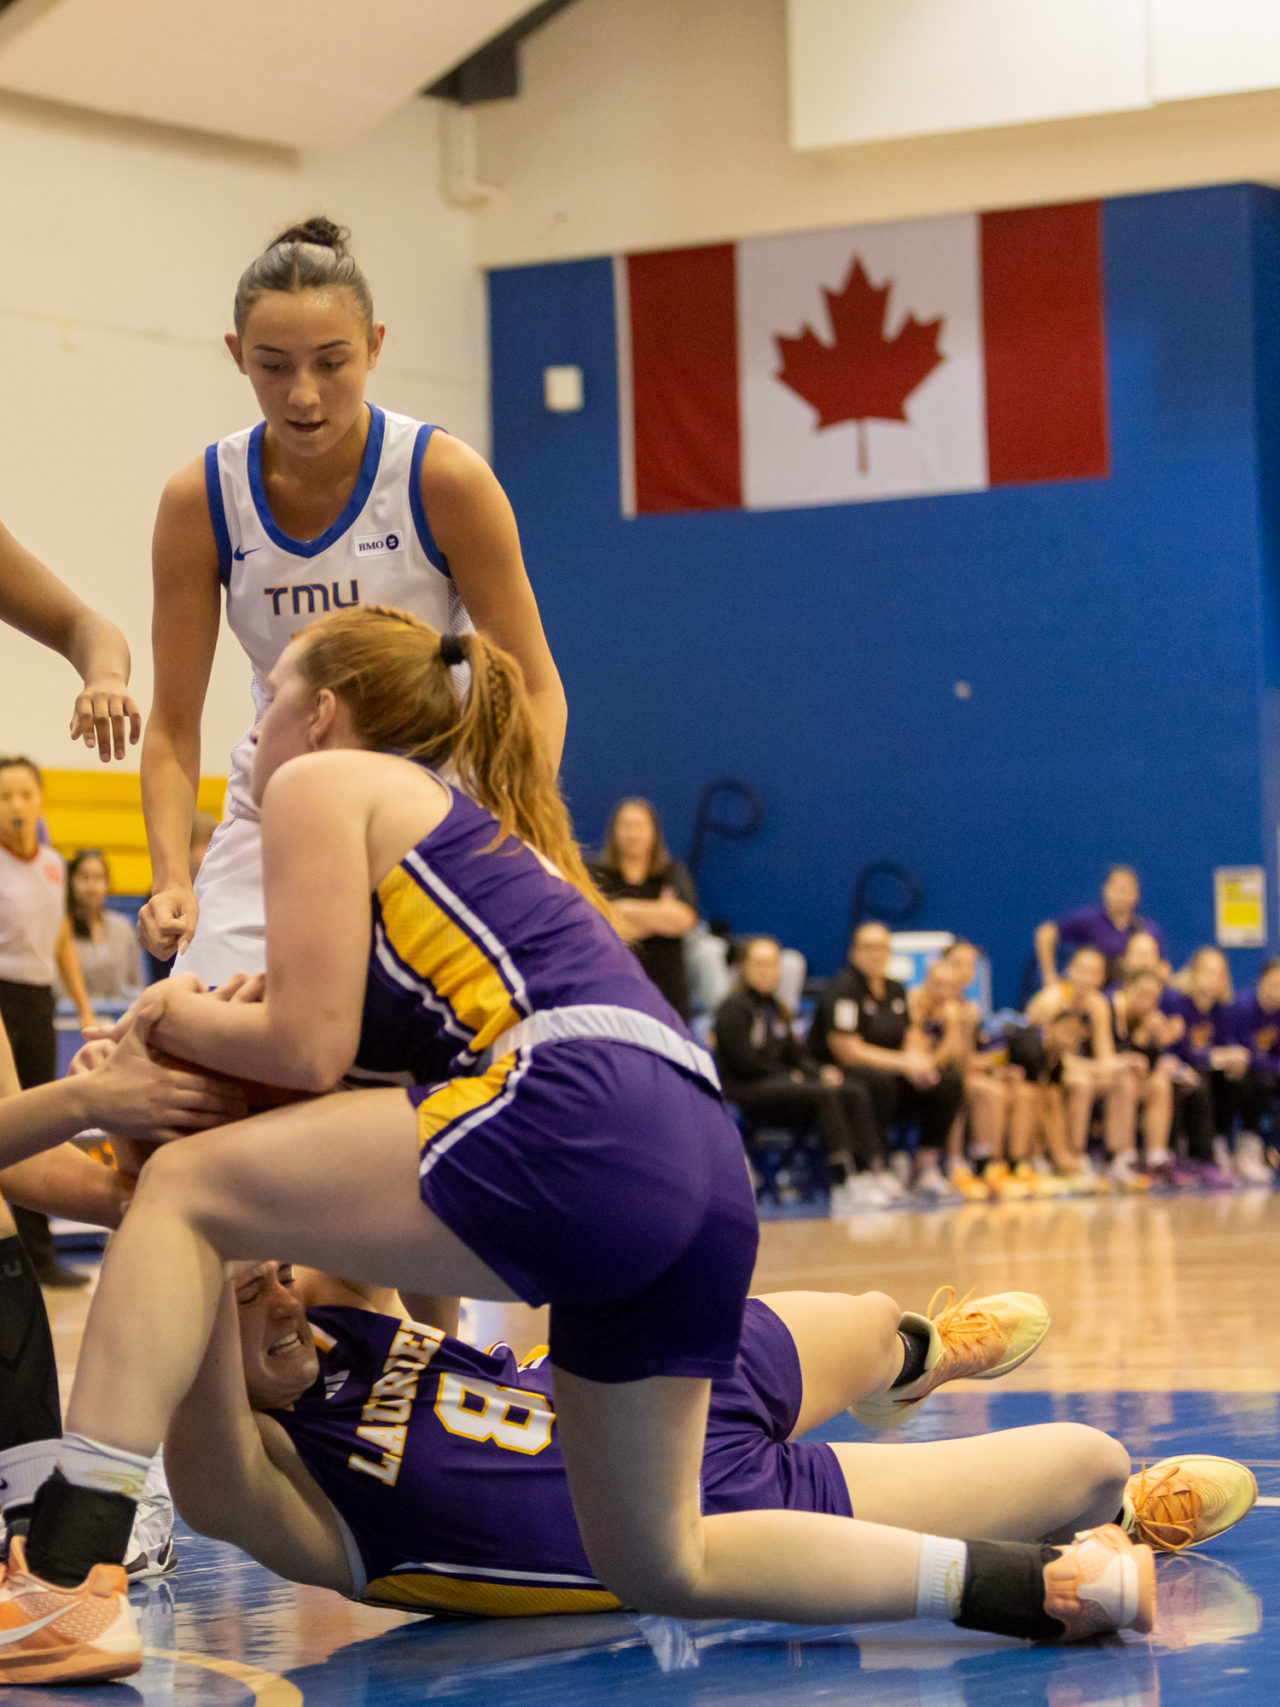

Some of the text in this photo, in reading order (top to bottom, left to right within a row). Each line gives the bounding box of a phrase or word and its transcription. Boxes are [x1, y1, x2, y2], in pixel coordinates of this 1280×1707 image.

[358, 540, 384, 552] BMO
[263, 579, 360, 616] TMU
[434, 1372, 557, 1456] 8
